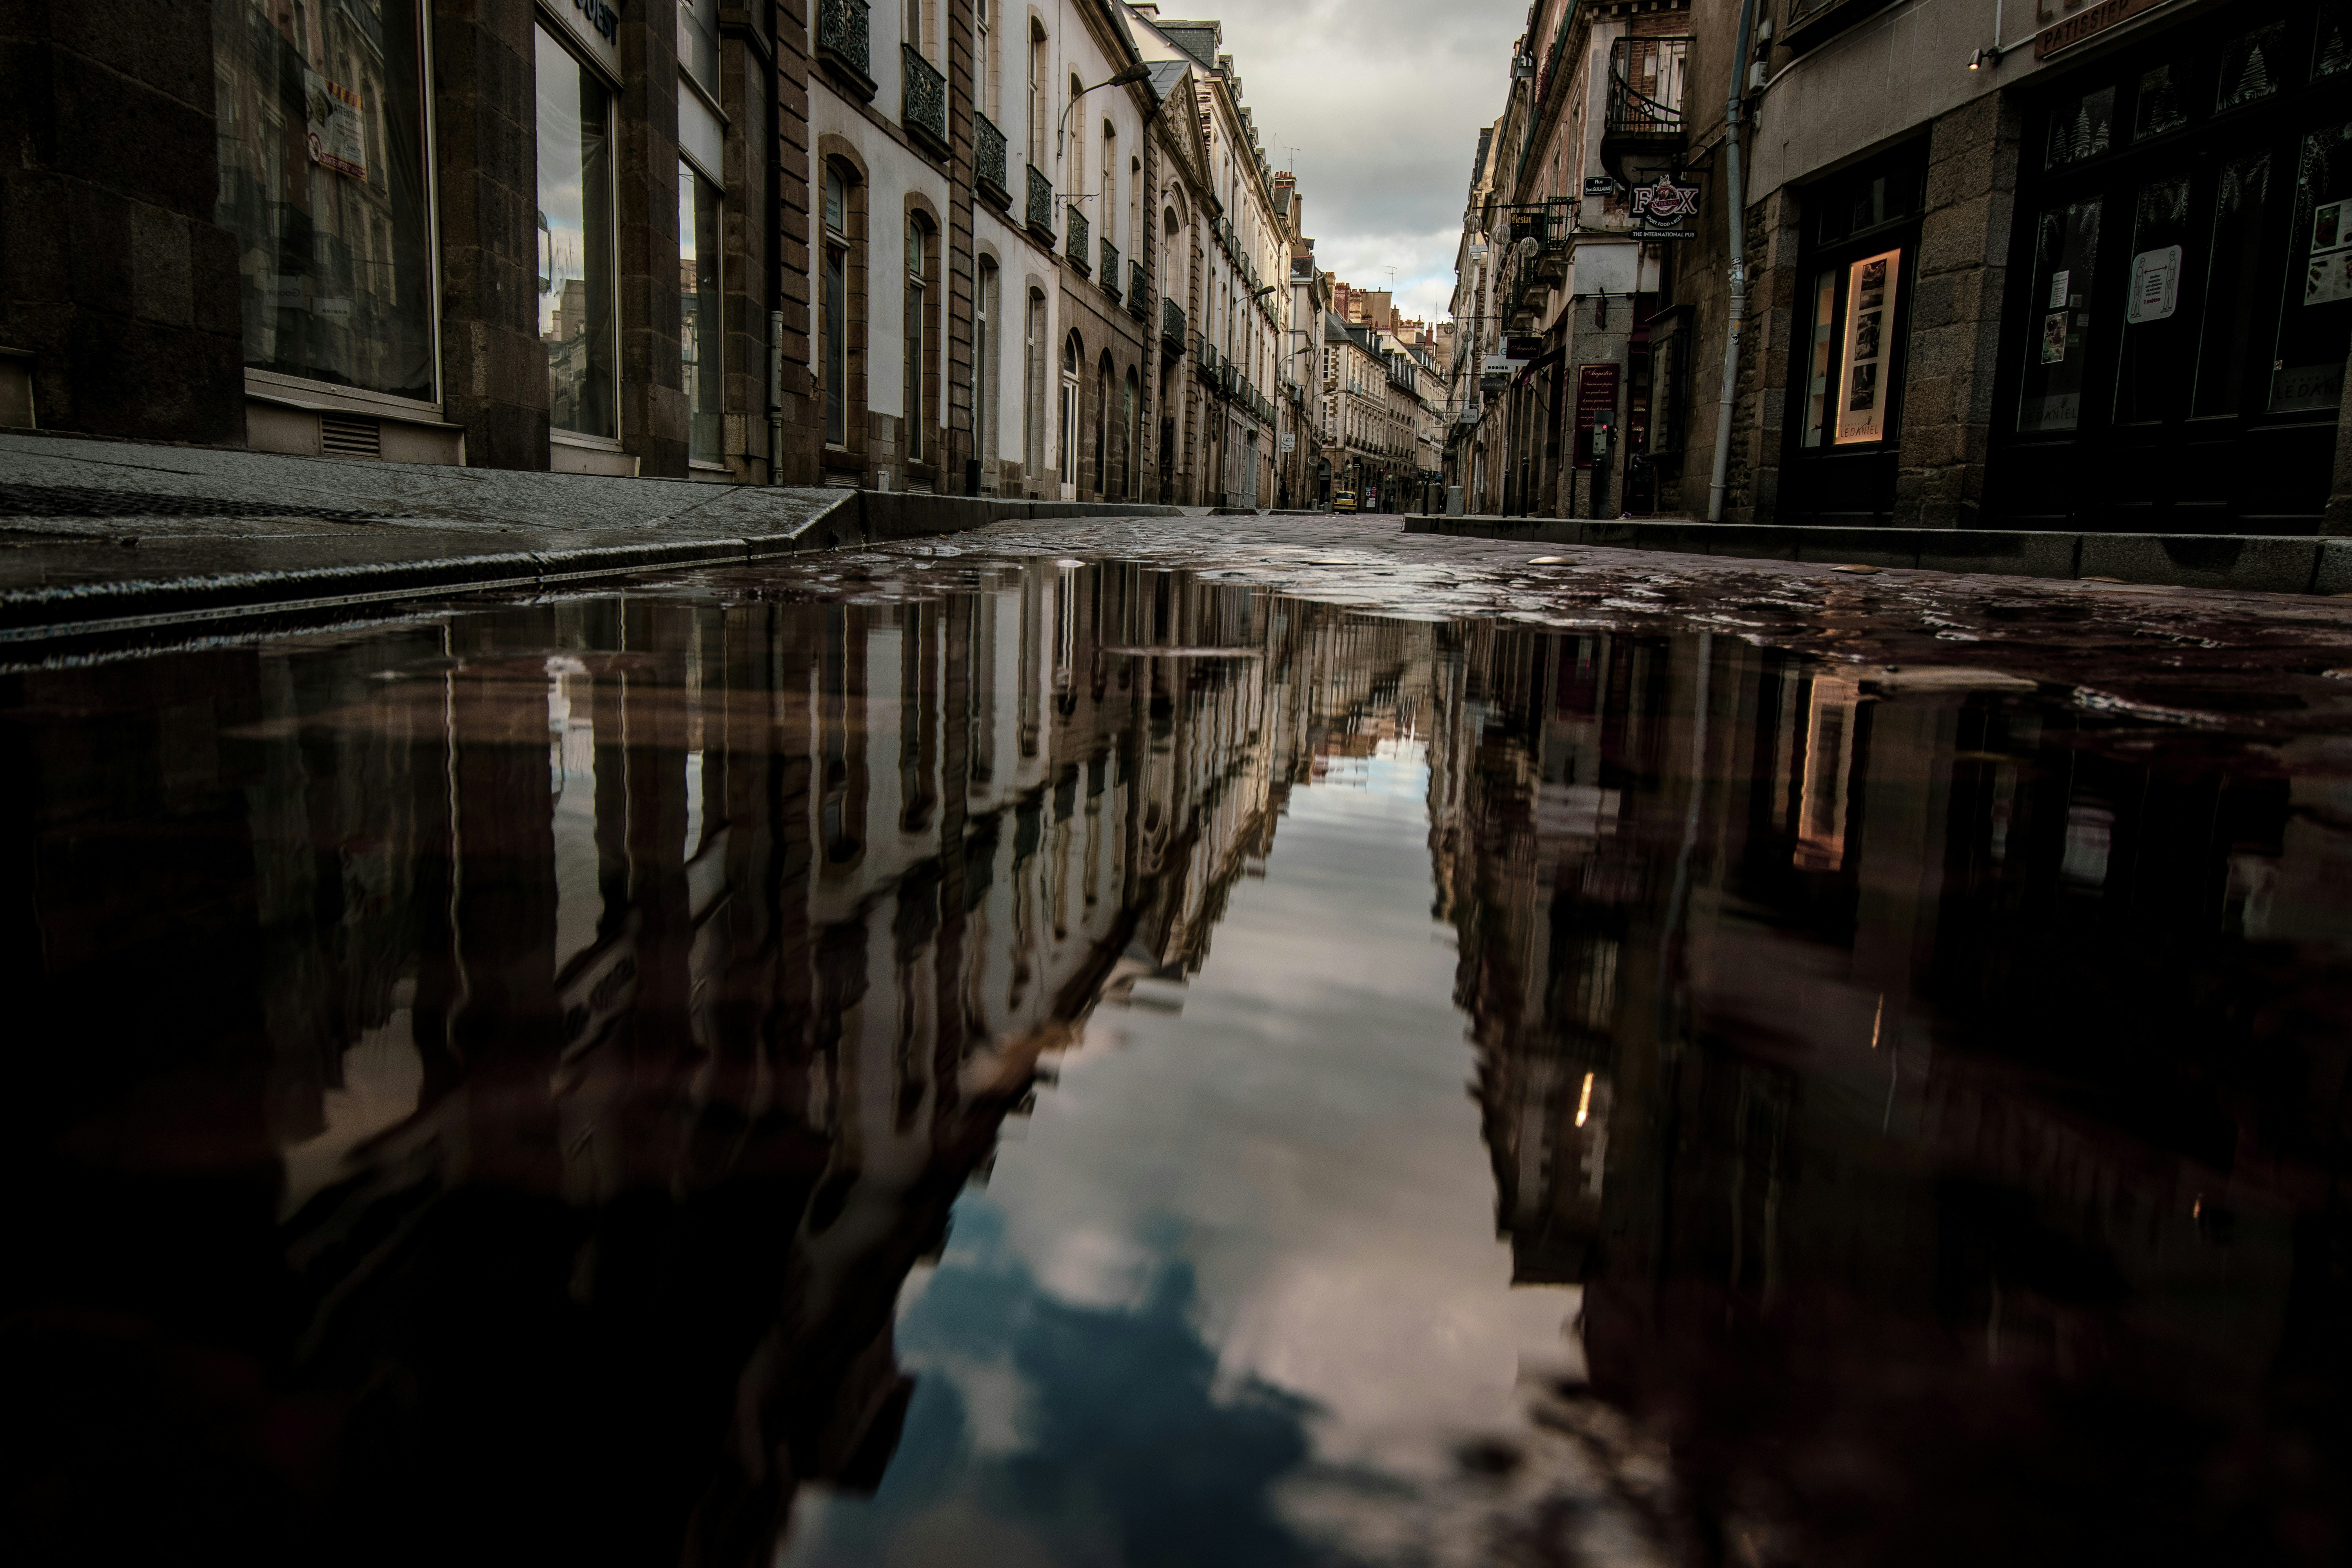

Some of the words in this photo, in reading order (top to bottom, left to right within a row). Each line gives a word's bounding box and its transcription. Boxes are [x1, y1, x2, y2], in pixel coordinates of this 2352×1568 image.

[334, 103, 363, 124] ATTENTION
[1673, 214, 1683, 224] BEER
[1584, 369, 1613, 378] Augustin
[2298, 381, 2341, 398] DANI
